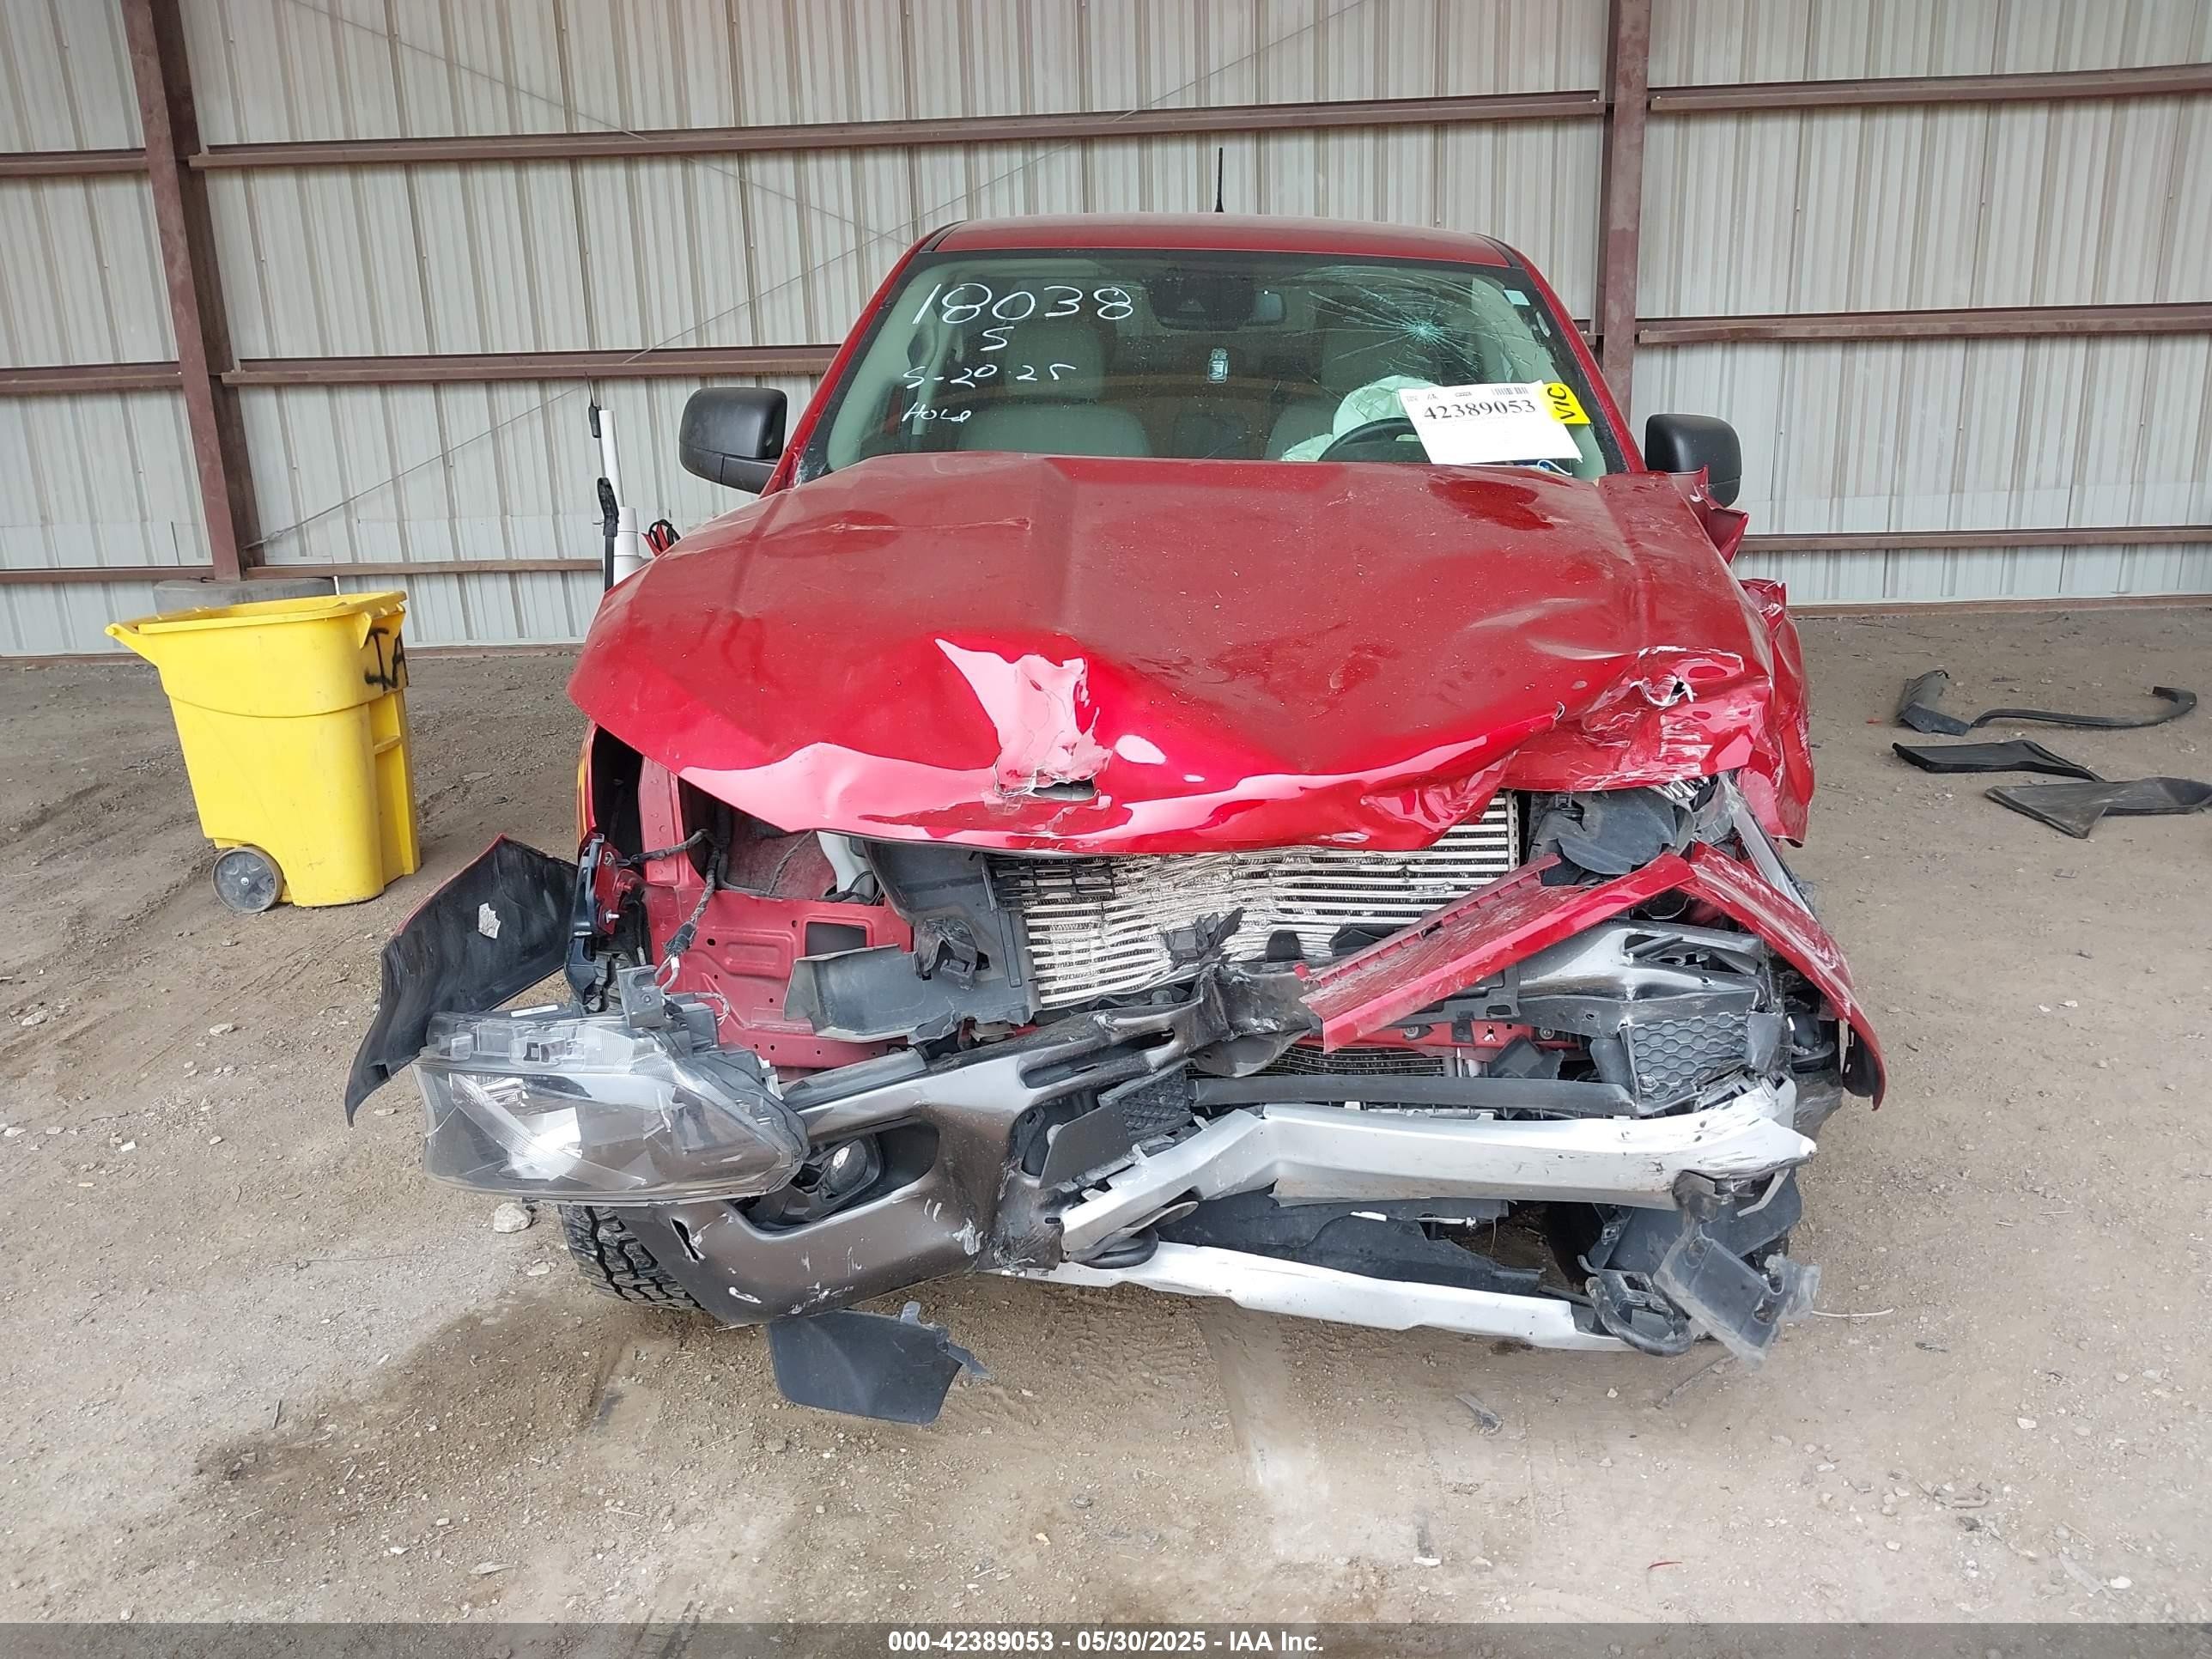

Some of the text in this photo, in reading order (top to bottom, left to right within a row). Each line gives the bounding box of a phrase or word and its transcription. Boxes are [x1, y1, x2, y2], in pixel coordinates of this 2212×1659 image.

[912, 283, 1134, 325] 18038
[1424, 399, 1536, 420] 42389053
[1547, 386, 1576, 420] VIC
